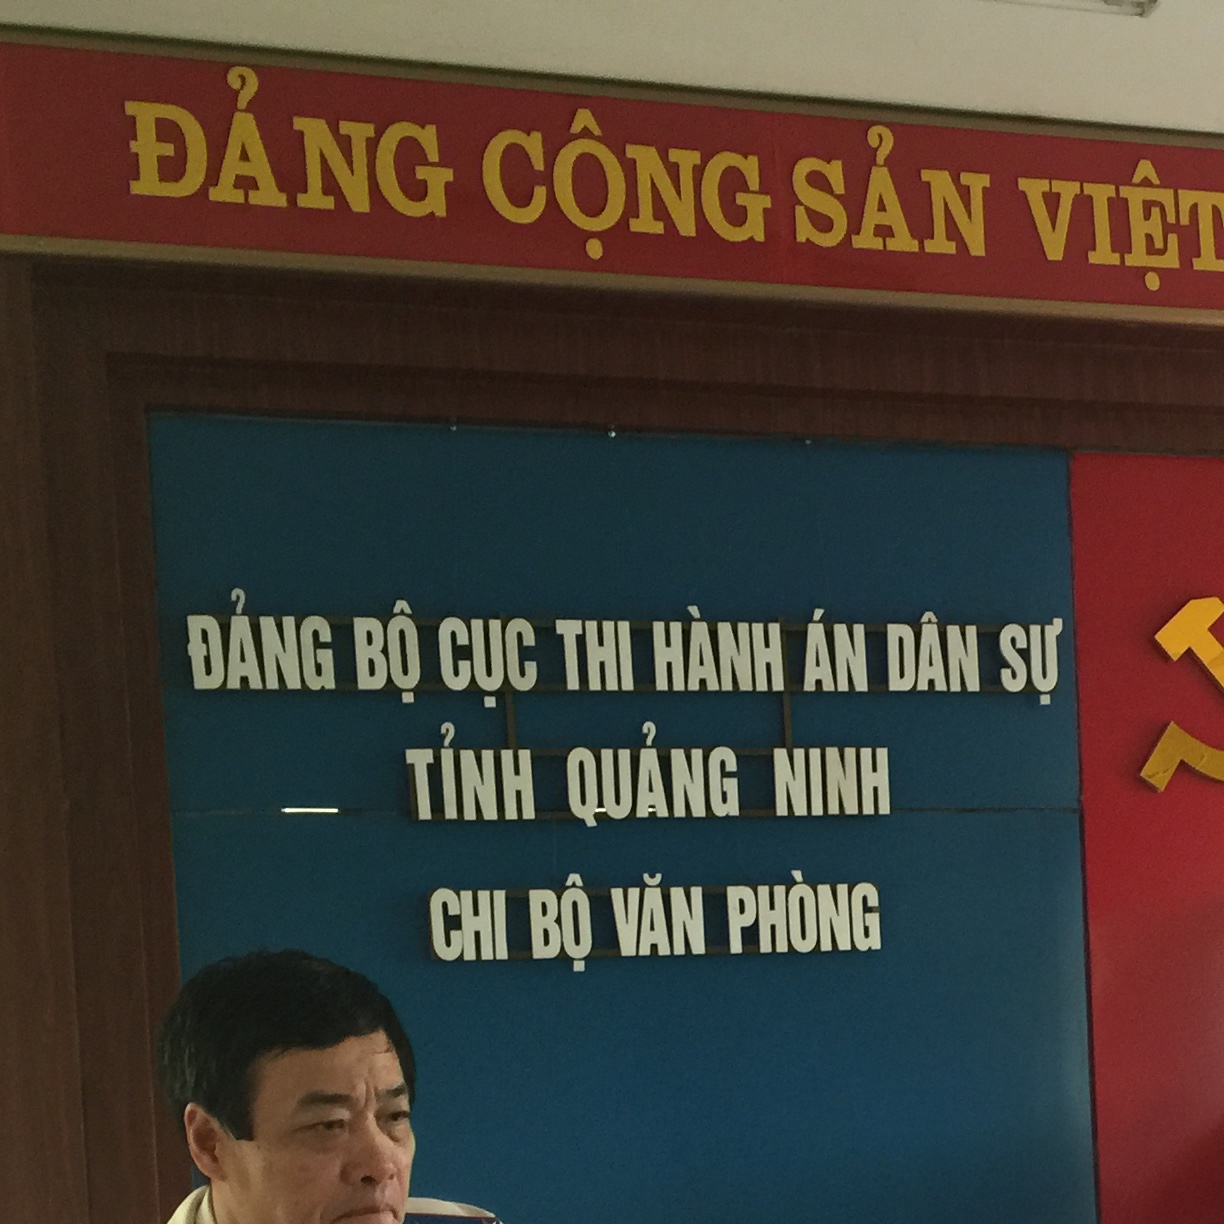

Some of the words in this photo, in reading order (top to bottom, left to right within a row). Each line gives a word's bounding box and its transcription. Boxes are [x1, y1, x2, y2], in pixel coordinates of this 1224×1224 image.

[124, 66, 453, 218] ĐẢNG
[481, 109, 771, 260] CỘNG
[792, 125, 990, 257] SẢN
[187, 588, 335, 690] ĐẢNG
[353, 600, 420, 703] BỘ
[438, 617, 537, 708] CỤC
[555, 619, 635, 691] THI
[652, 605, 784, 691] HÀNH
[803, 608, 868, 692] ÁN
[887, 611, 980, 692] DÂN
[1000, 618, 1063, 705] SỰ
[405, 722, 536, 820] TỈNH
[566, 721, 739, 827] QUẢNG
[773, 747, 891, 817] NINH
[429, 888, 508, 961] CHI
[529, 873, 593, 972] BỘ
[610, 873, 706, 957] VĂN
[726, 870, 881, 954] PHÒNG
